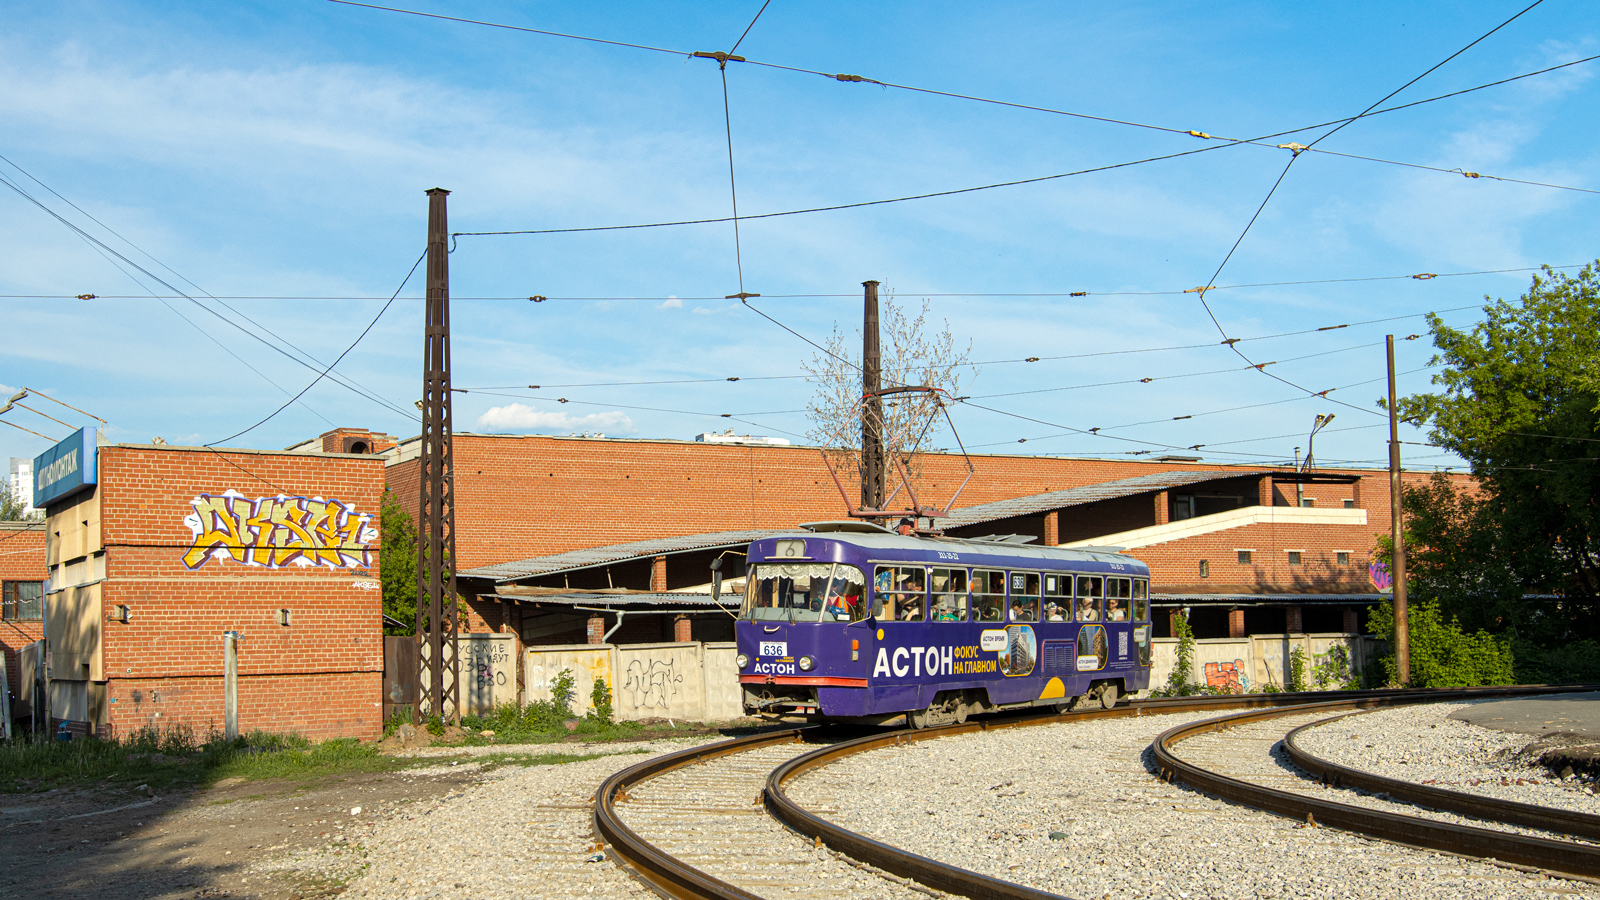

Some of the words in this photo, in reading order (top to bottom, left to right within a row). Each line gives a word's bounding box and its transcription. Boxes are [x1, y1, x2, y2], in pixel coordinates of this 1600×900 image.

[785, 541, 795, 557] 6
[458, 643, 505, 655] УССКИЕ
[763, 645, 783, 656] 636
[954, 645, 979, 659] ФОКУС
[754, 663, 795, 674] АСТОН
[872, 646, 953, 678] АСТОН
[953, 661, 964, 675] НА
[965, 660, 997, 674] ГЛАВНОМ
